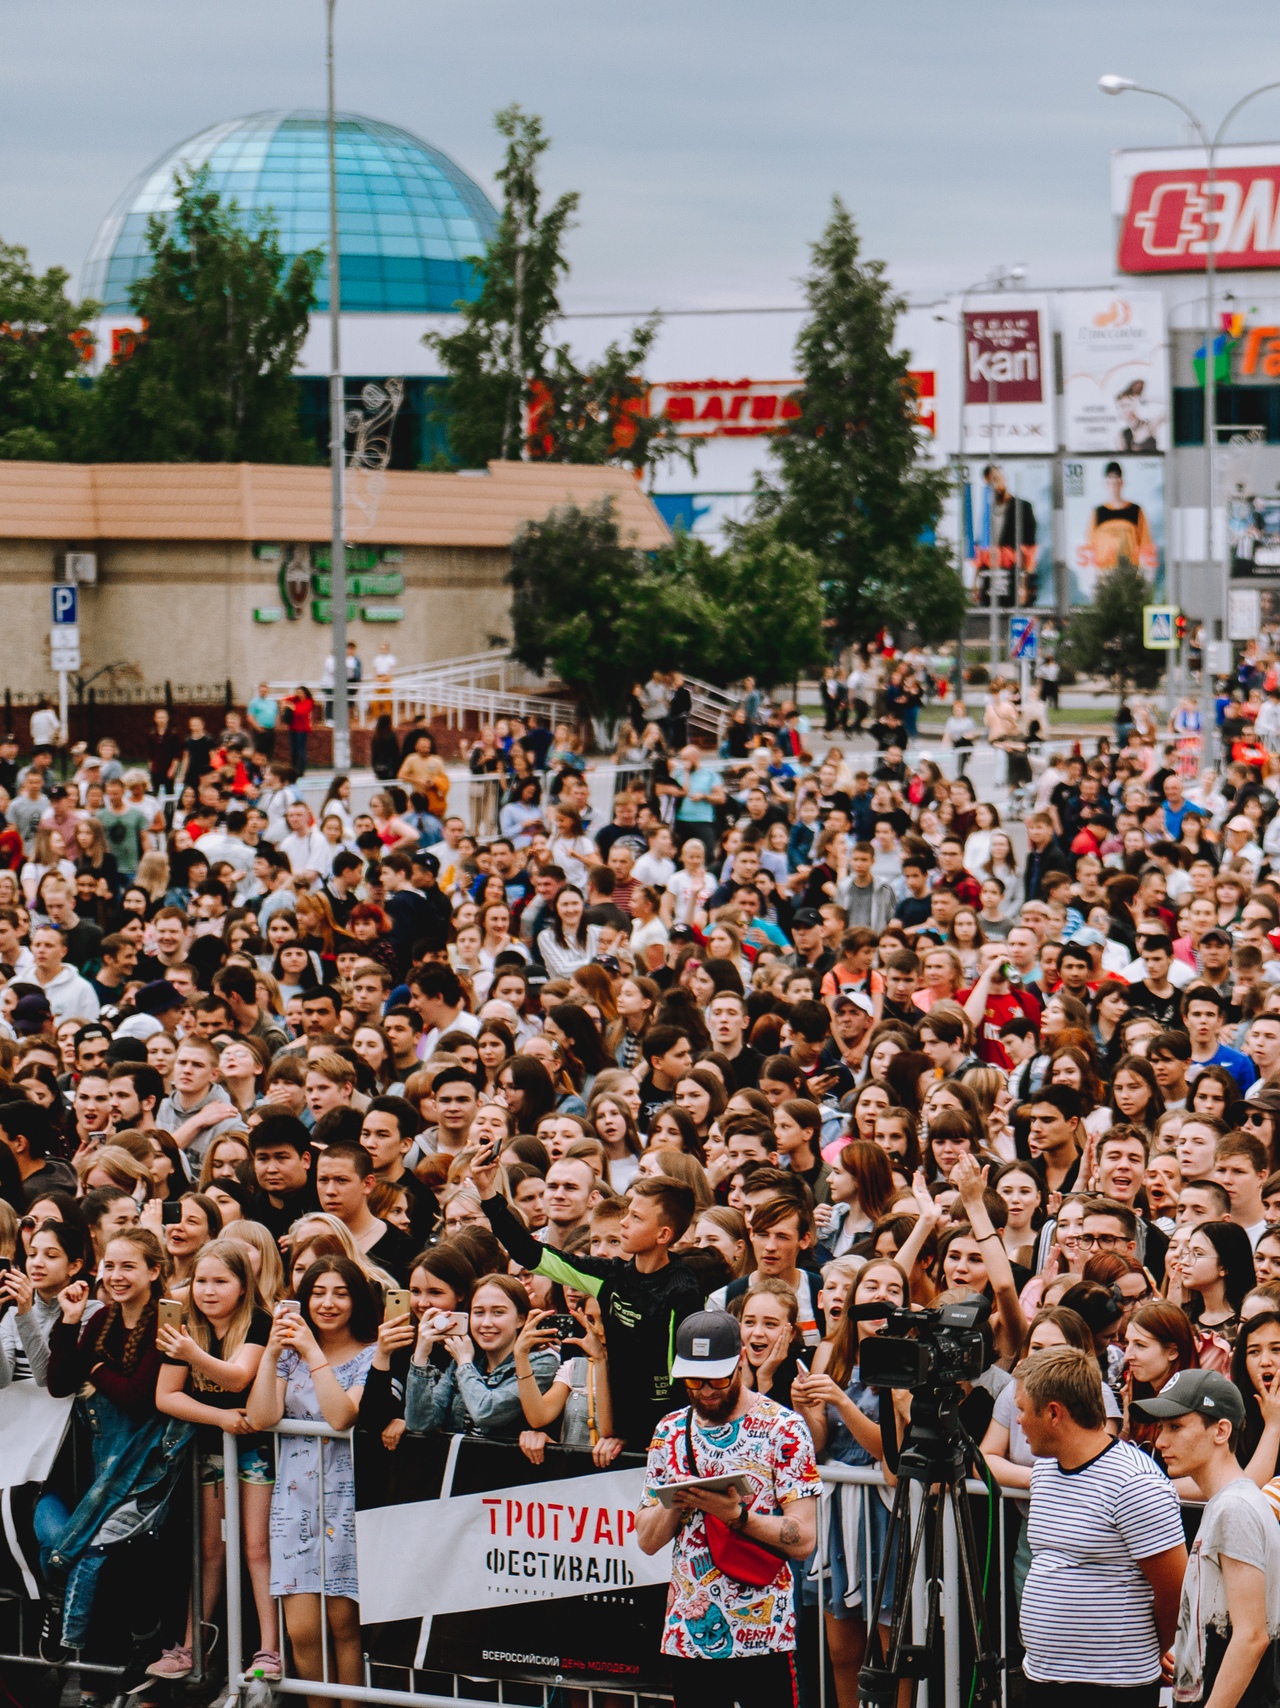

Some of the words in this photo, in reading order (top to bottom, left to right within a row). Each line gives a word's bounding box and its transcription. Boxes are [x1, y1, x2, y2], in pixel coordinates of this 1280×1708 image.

[967, 340, 1040, 383] kari
[979, 424, 1044, 438] ЭТАЖ
[56, 588, 73, 622] P
[742, 1416, 779, 1431] DEATH
[747, 1429, 769, 1438] SLICE
[709, 1449, 724, 1460] LIVE
[482, 1498, 635, 1547] ТРОТУАР
[486, 1548, 634, 1586] ФЕСТИВАЛЬ
[583, 1594, 635, 1605] СПОРТА
[735, 1626, 777, 1643] DEATH
[742, 1640, 769, 1650] SLICE
[482, 1650, 560, 1667] ВСЕРОССИЙСКИЙ
[561, 1658, 586, 1670] ДЕНЬ
[587, 1661, 640, 1674] МОЛОДЕЖИ
